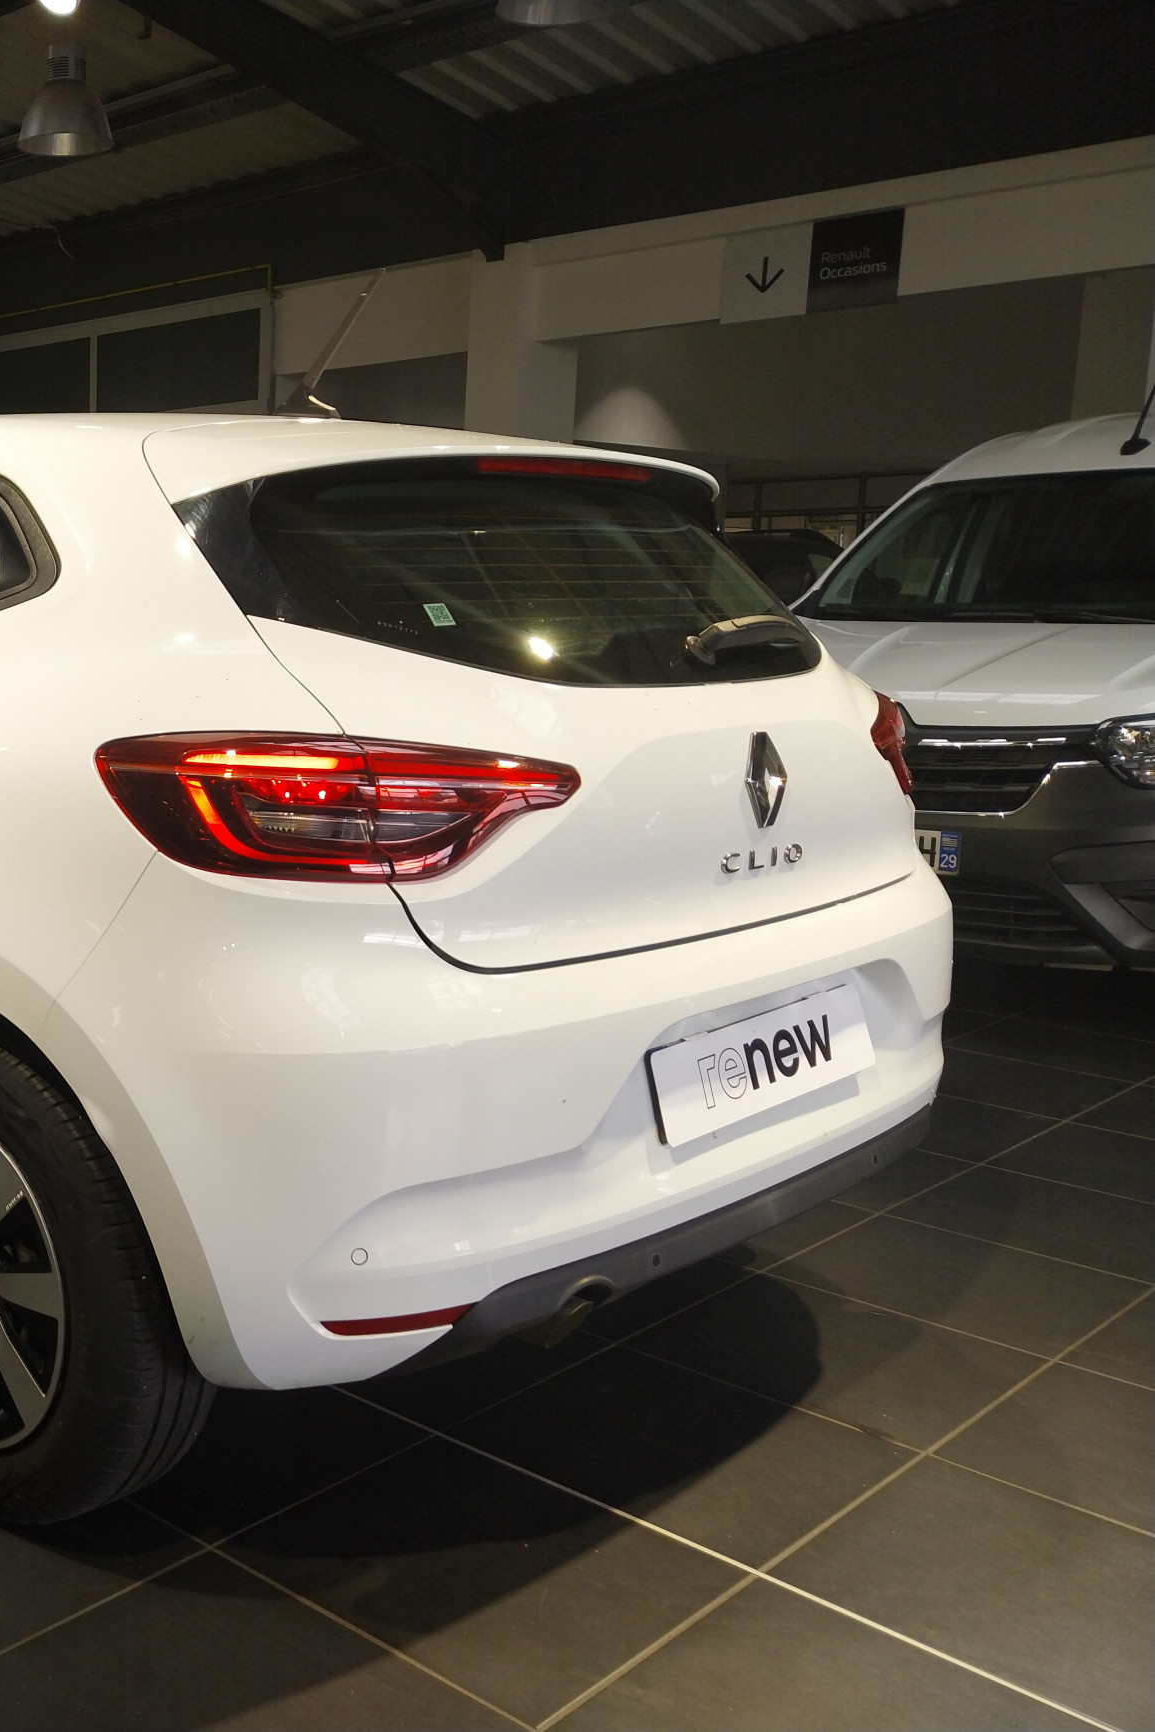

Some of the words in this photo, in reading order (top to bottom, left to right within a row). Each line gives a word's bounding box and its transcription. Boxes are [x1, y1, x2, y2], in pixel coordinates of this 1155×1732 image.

[821, 246, 872, 265] Renault
[819, 261, 888, 280] Occasions
[720, 843, 803, 875] CLIO
[940, 853, 958, 869] 29
[697, 1013, 833, 1110] renew
